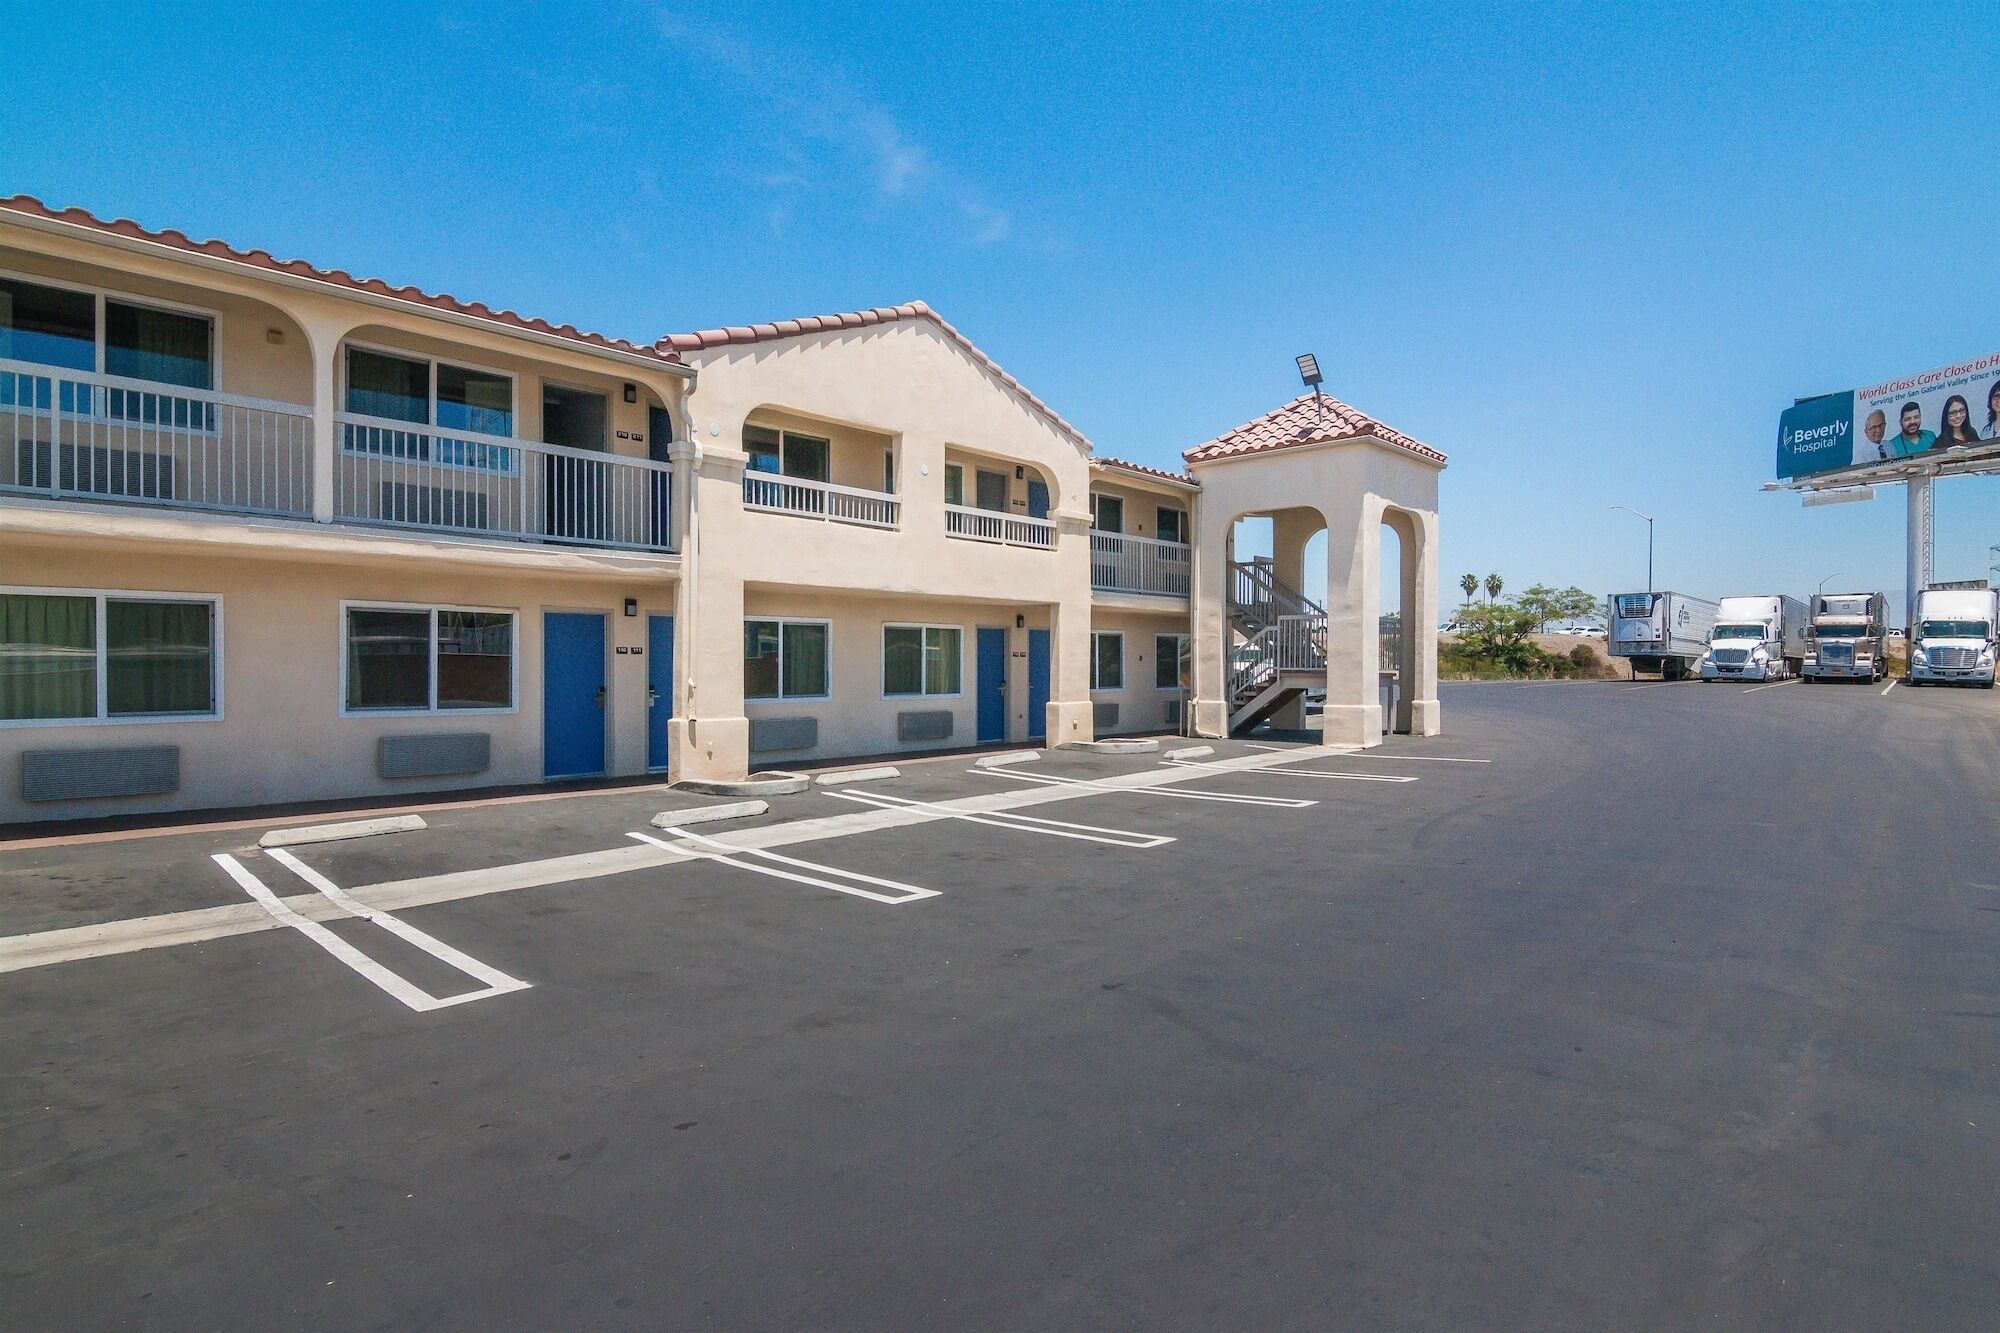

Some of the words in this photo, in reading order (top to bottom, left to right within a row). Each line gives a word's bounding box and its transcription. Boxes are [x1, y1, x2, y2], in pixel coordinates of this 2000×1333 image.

[1859, 383, 1888, 400] World
[1889, 381, 1915, 393] Class
[1917, 372, 1942, 385] Care
[1944, 364, 1973, 378] Close
[1975, 359, 1987, 370] to
[1989, 354, 2000, 366] H
[1870, 396, 1893, 407] Serving
[1895, 391, 1905, 400] the
[1907, 388, 1919, 398] San
[1921, 381, 1946, 394] Gabriel
[1947, 376, 1969, 388] Valley
[1970, 372, 1989, 382] Since
[1793, 435, 1836, 454] Hospital
[1794, 419, 1849, 443] Beverly
